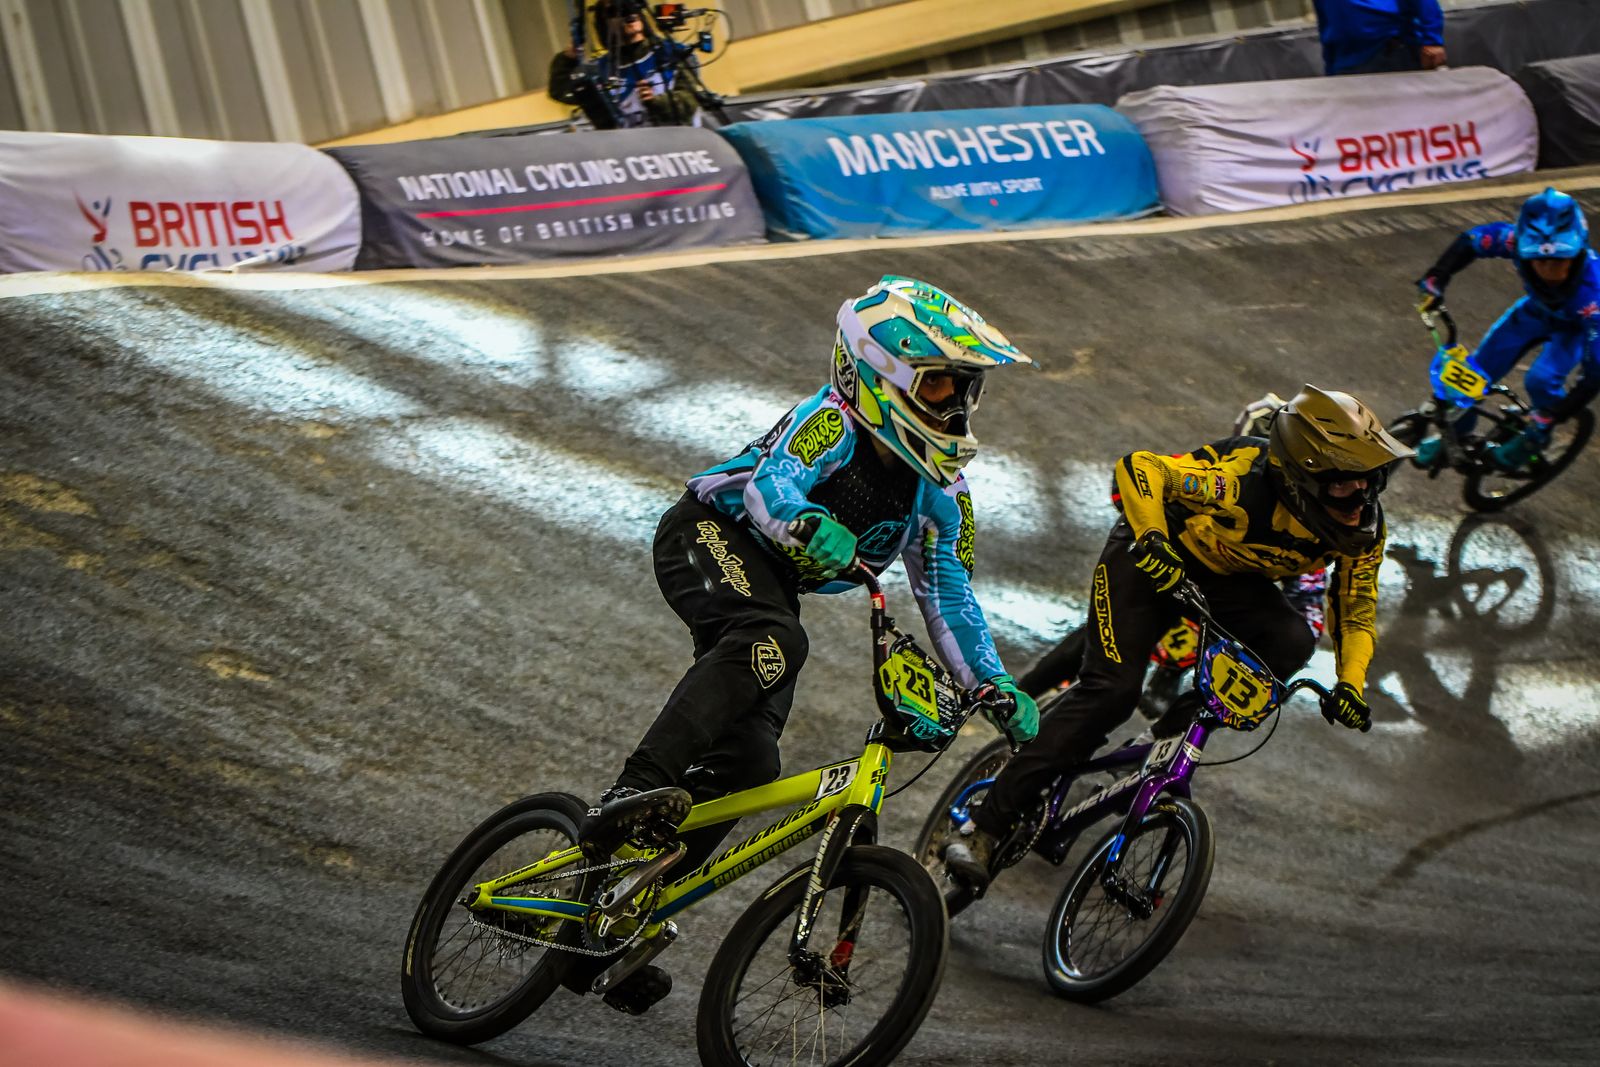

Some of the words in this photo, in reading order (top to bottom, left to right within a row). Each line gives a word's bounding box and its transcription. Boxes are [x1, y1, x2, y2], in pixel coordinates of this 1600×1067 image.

[827, 119, 1105, 177] MANCHESTER
[1336, 121, 1483, 173] BRITISH
[398, 167, 527, 201] NATIONAL
[525, 157, 627, 191] CYCLING
[625, 150, 720, 181] CENTRE
[929, 183, 969, 200] ALIVE
[968, 181, 1004, 196] WITH
[1001, 177, 1044, 194] SPORT
[129, 200, 294, 248] BRITISH
[421, 228, 486, 248] HOME
[499, 225, 525, 244] OF
[538, 213, 634, 241] BRITISH
[643, 202, 736, 228] CYCLING
[1445, 365, 1478, 393] 32
[903, 664, 933, 704] 23
[1219, 667, 1258, 709] 13
[1155, 741, 1172, 761] 13
[824, 765, 851, 793] 23
